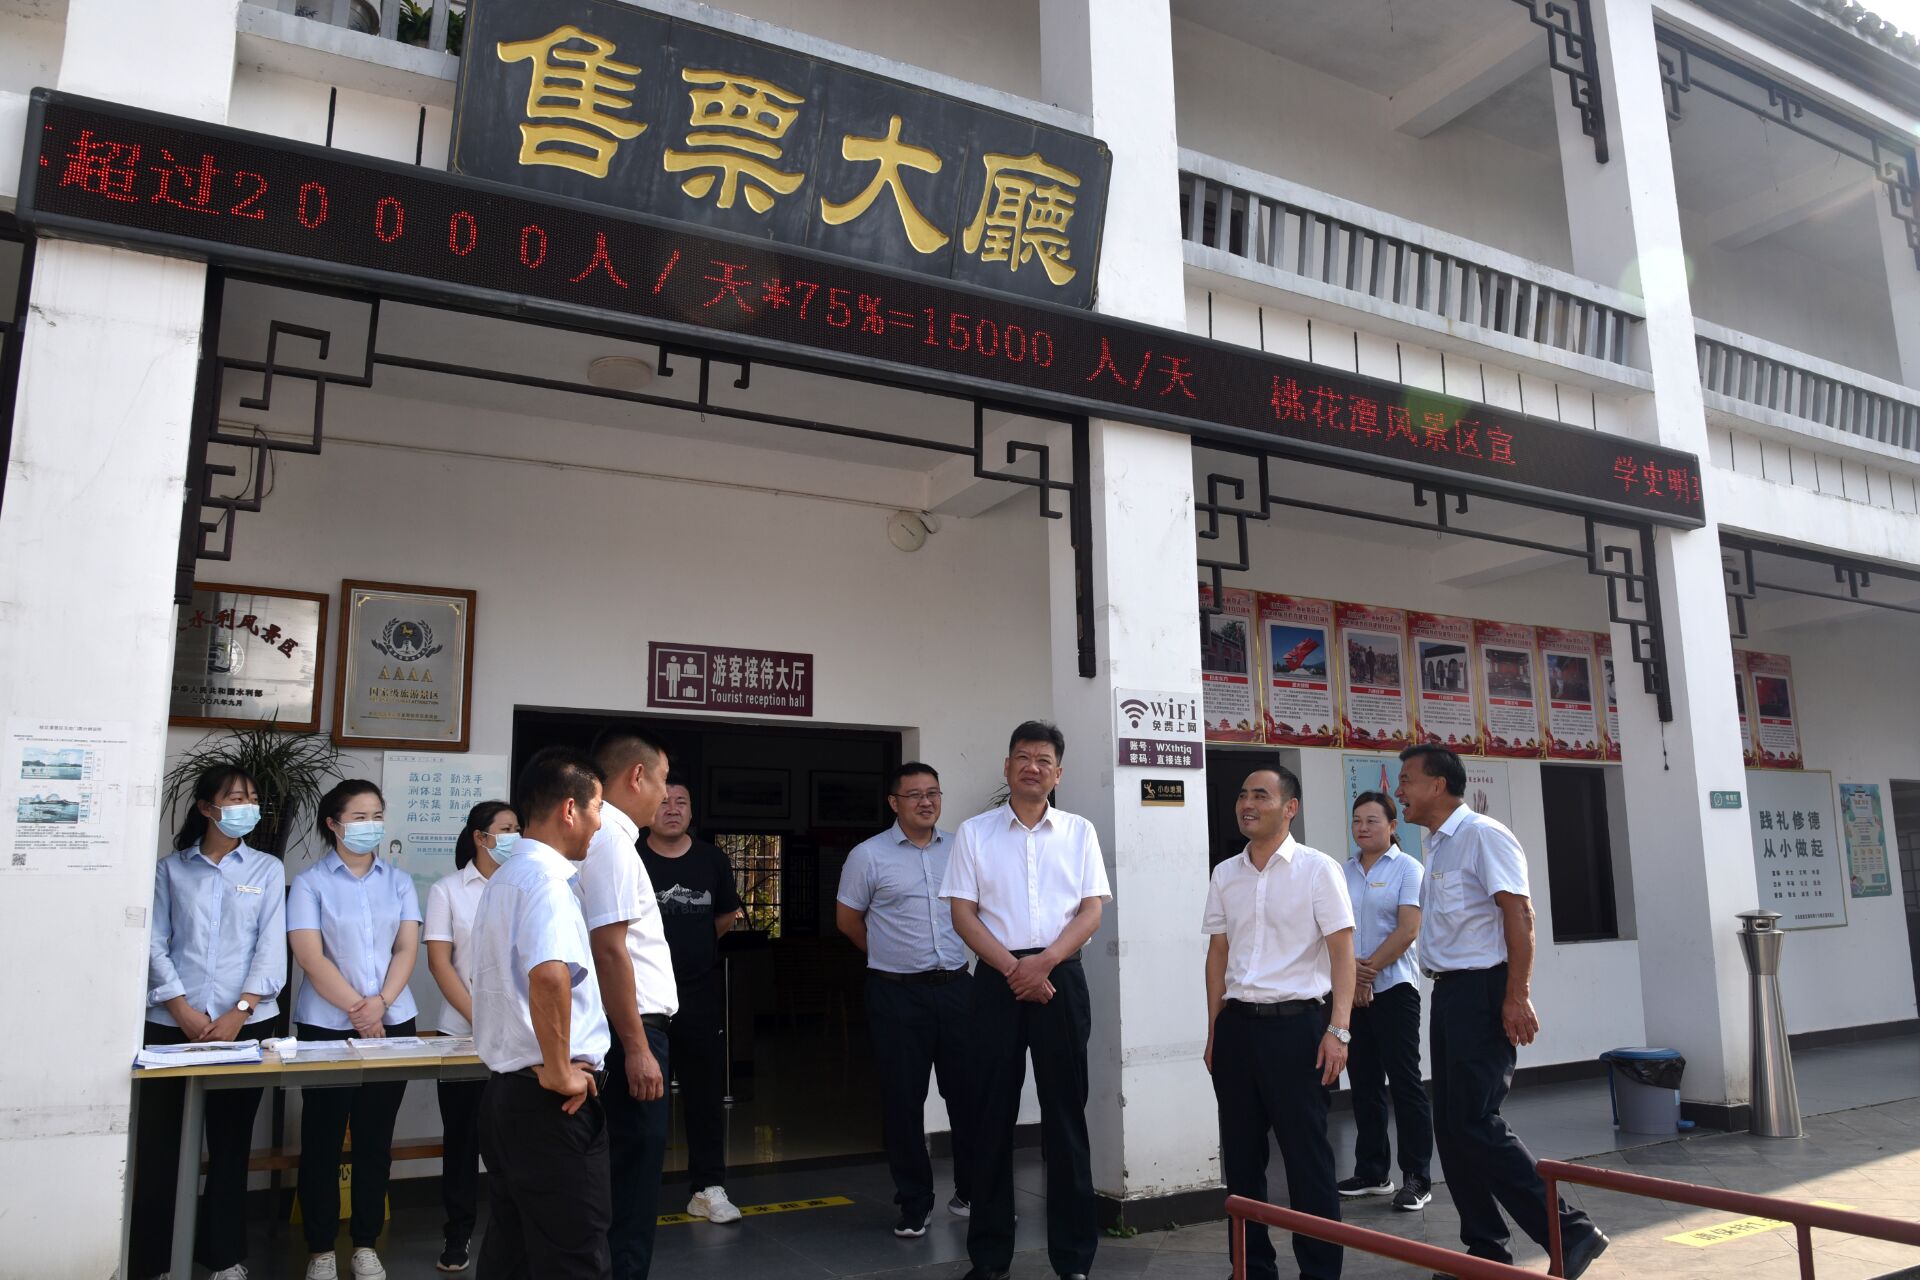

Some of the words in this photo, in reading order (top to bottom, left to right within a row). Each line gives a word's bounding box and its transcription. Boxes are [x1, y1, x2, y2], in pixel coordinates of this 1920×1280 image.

[496, 24, 1082, 286] 售票大廳
[178, 608, 299, 660] 水利风景区
[712, 653, 806, 691] 游客接待大厅
[711, 688, 743, 704] Tourist
[745, 693, 787, 708] reception
[788, 694, 805, 708] hall
[1149, 697, 1198, 720] WiFi
[1152, 720, 1197, 733] 免费上网
[1759, 810, 1821, 831] 践礼修德
[1763, 838, 1825, 859] 从小做起
